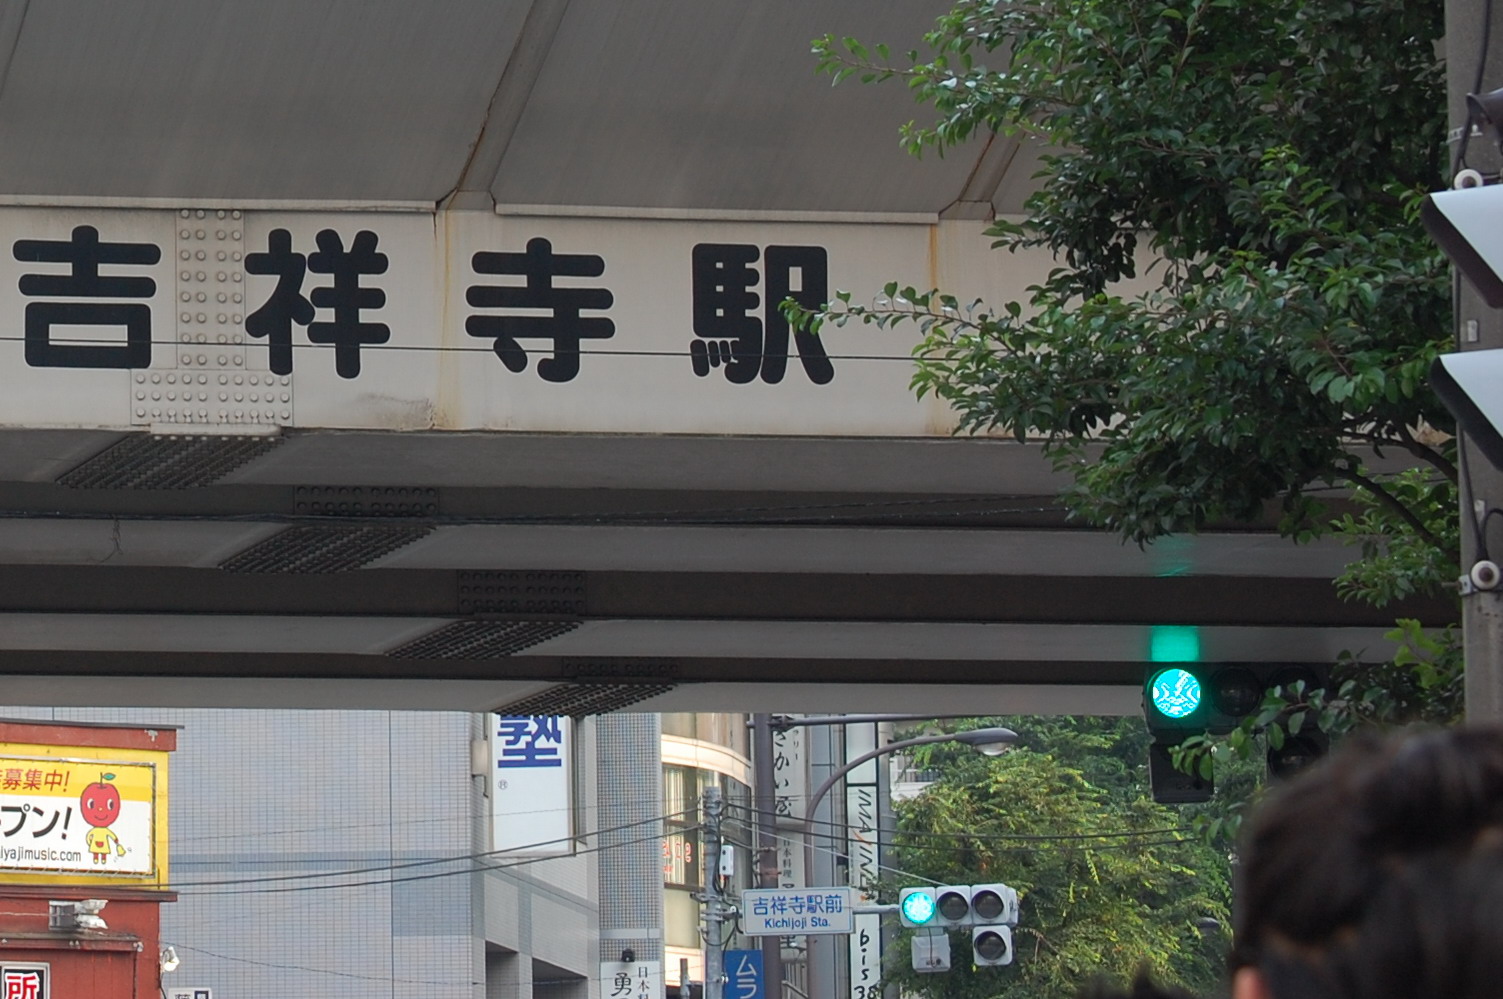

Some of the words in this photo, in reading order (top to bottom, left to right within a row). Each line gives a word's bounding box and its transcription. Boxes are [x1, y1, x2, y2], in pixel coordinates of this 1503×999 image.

[497, 714, 562, 768] 塾
[753, 894, 842, 916] 吉祥寺駅前
[764, 917, 807, 930] Kichijoji
[810, 916, 831, 928] Sta.
